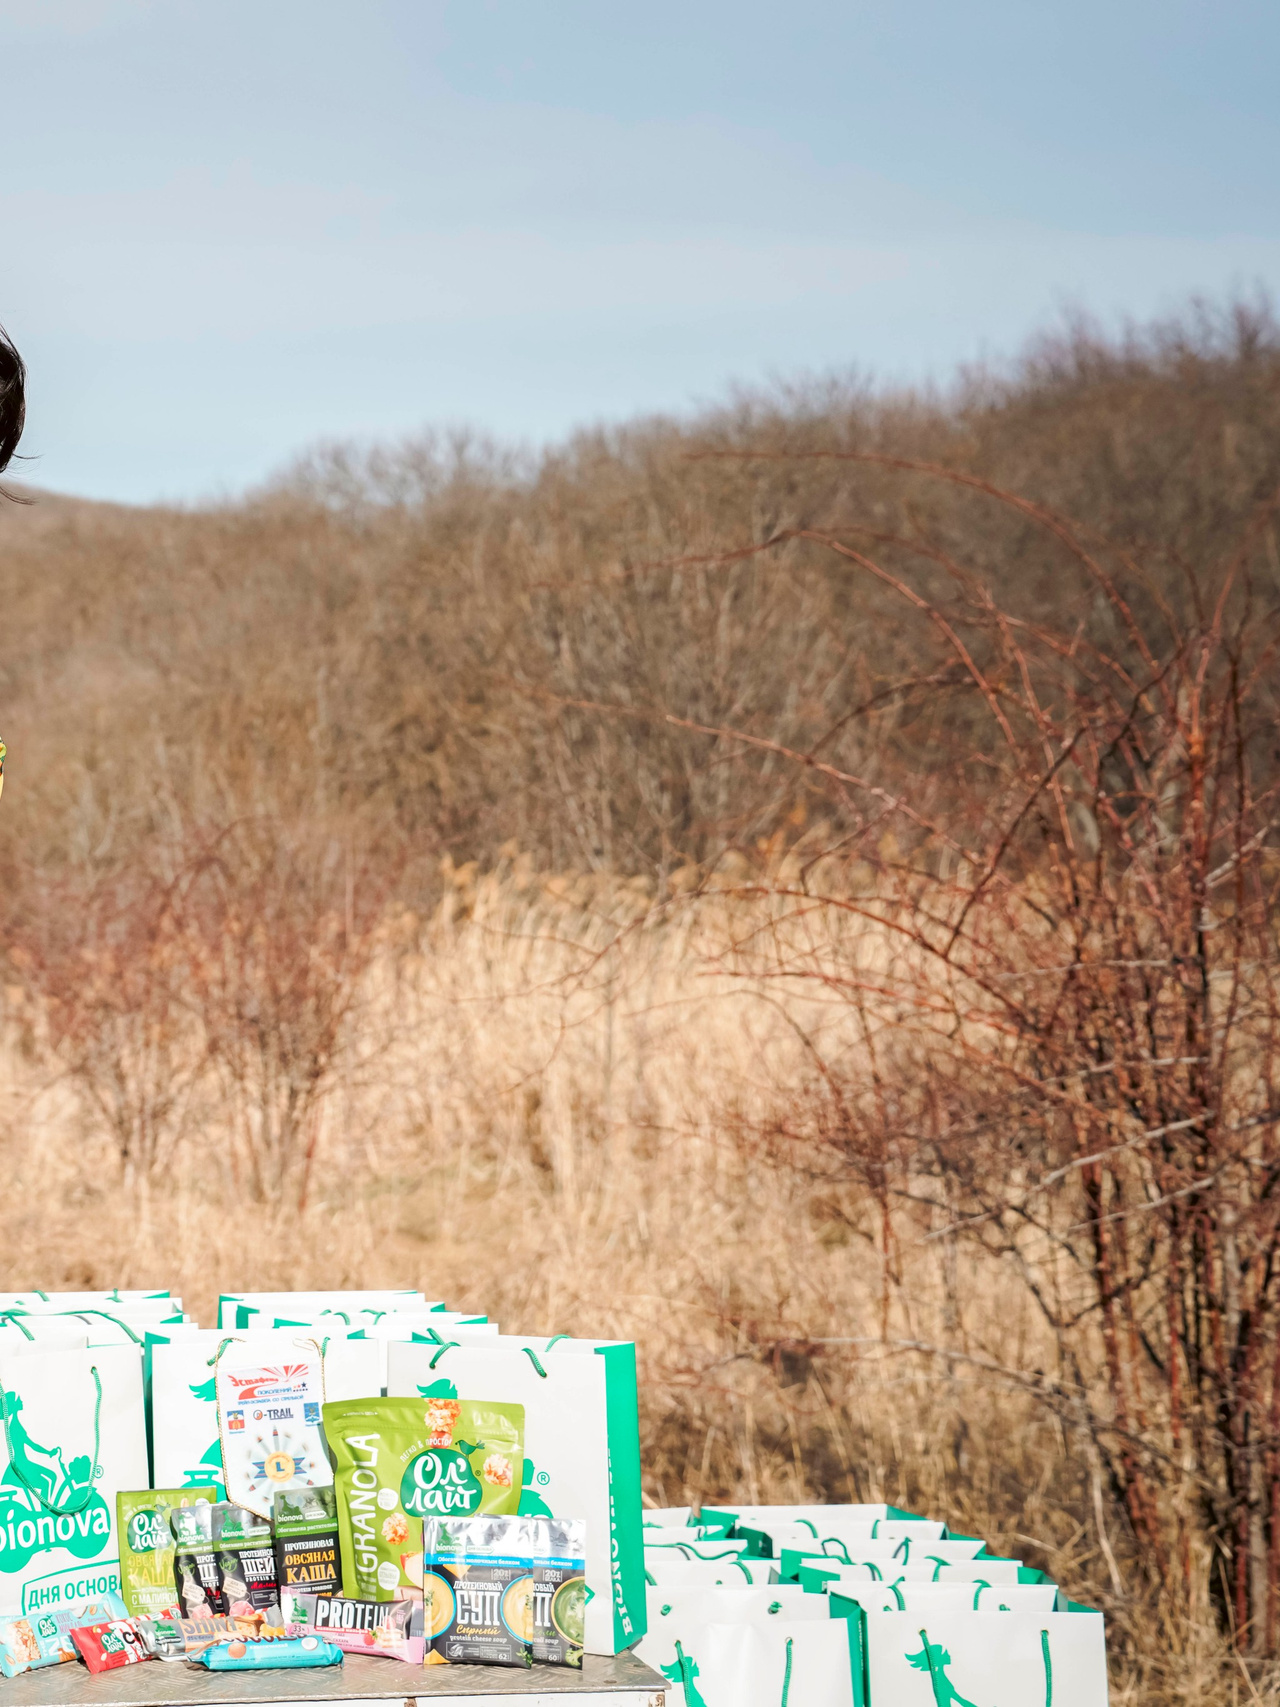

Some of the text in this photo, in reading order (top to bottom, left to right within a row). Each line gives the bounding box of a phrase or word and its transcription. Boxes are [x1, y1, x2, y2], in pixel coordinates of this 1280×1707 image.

[400, 1444, 417, 1462] ЛЕГКО
[345, 1433, 381, 1573] GRANOLA
[405, 1486, 477, 1513] лайт
[277, 1514, 303, 1522] bionova
[131, 1530, 170, 1550] лайт
[284, 1539, 334, 1551] ПРОТЕИНОВАЯ
[196, 1554, 215, 1563] ПРОТ
[285, 1550, 335, 1565] ОВСЯНАЯ
[498, 1558, 520, 1566] белком
[286, 1563, 337, 1584] КАША
[453, 1580, 504, 1591] ПРОТЕИНОВЫЙ
[28, 1585, 60, 1611] ДНЯ
[316, 1600, 389, 1630] PROTEIN
[456, 1591, 501, 1626] СУП
[450, 1634, 471, 1642] protein
